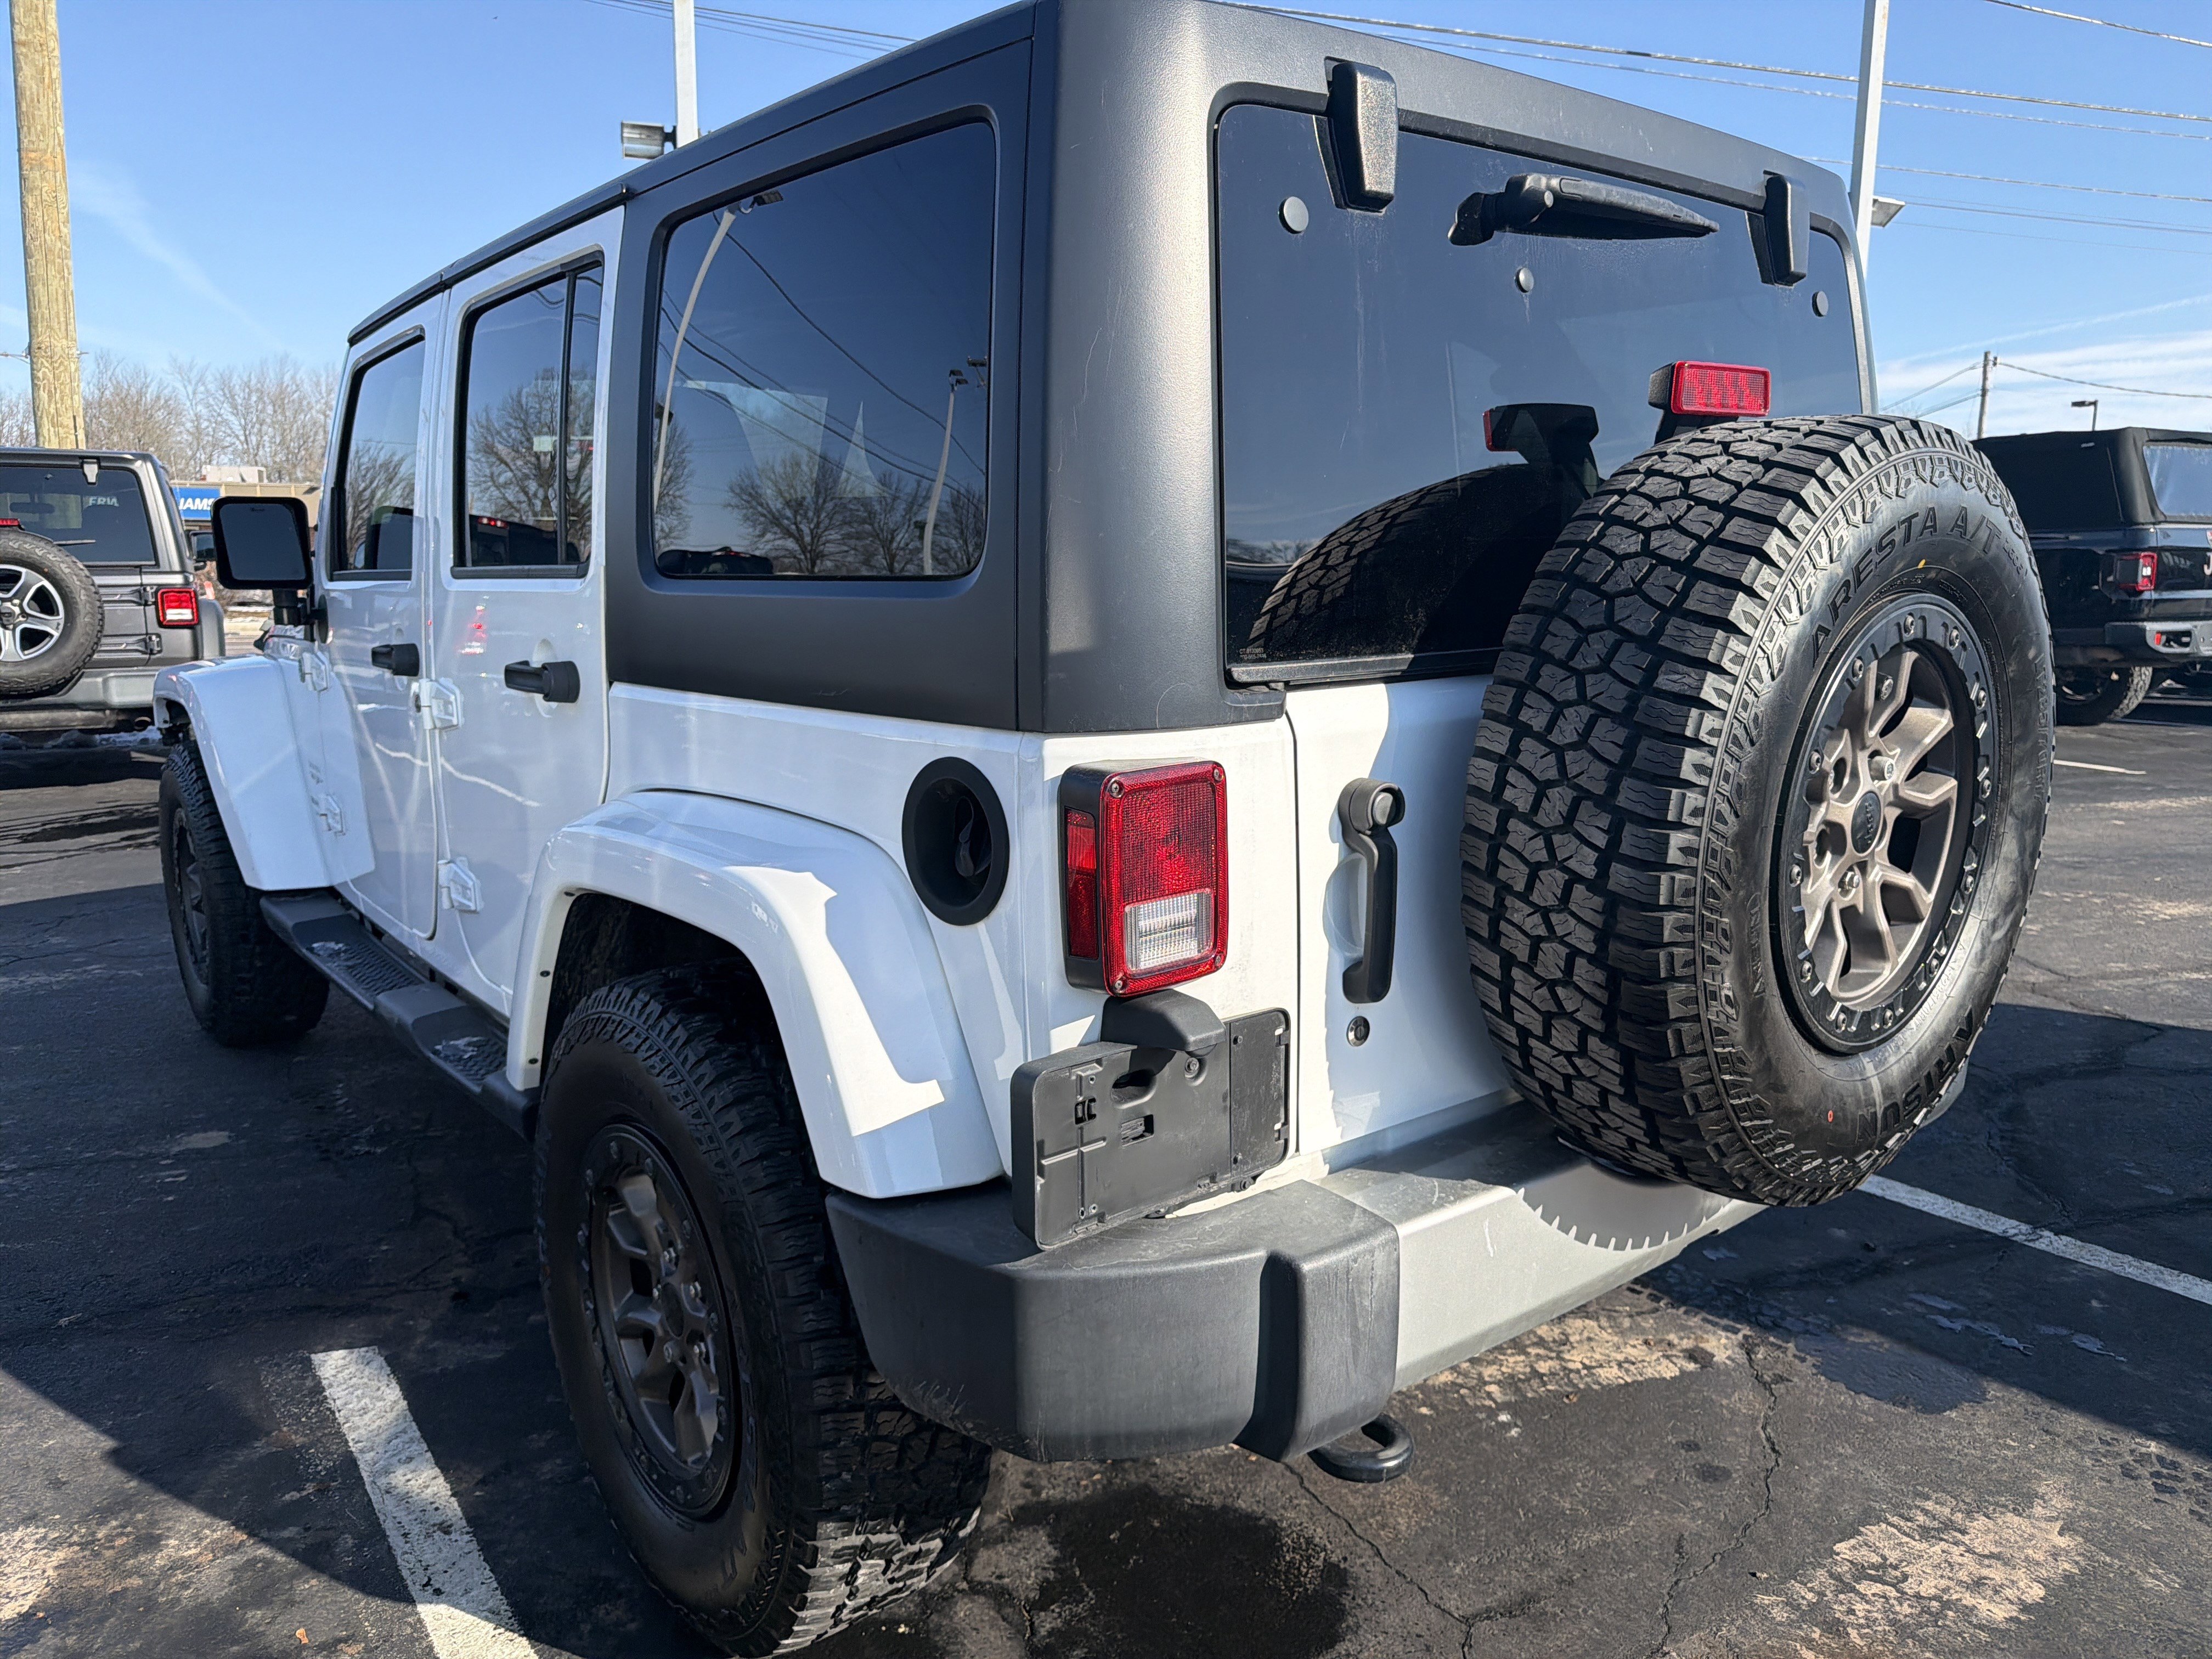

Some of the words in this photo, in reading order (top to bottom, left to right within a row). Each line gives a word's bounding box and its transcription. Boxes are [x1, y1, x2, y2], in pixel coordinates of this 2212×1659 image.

[1813, 505, 1938, 667] ARESTA
[1946, 505, 2002, 555] A/T
[1855, 1005, 1973, 1143] ARISUN
